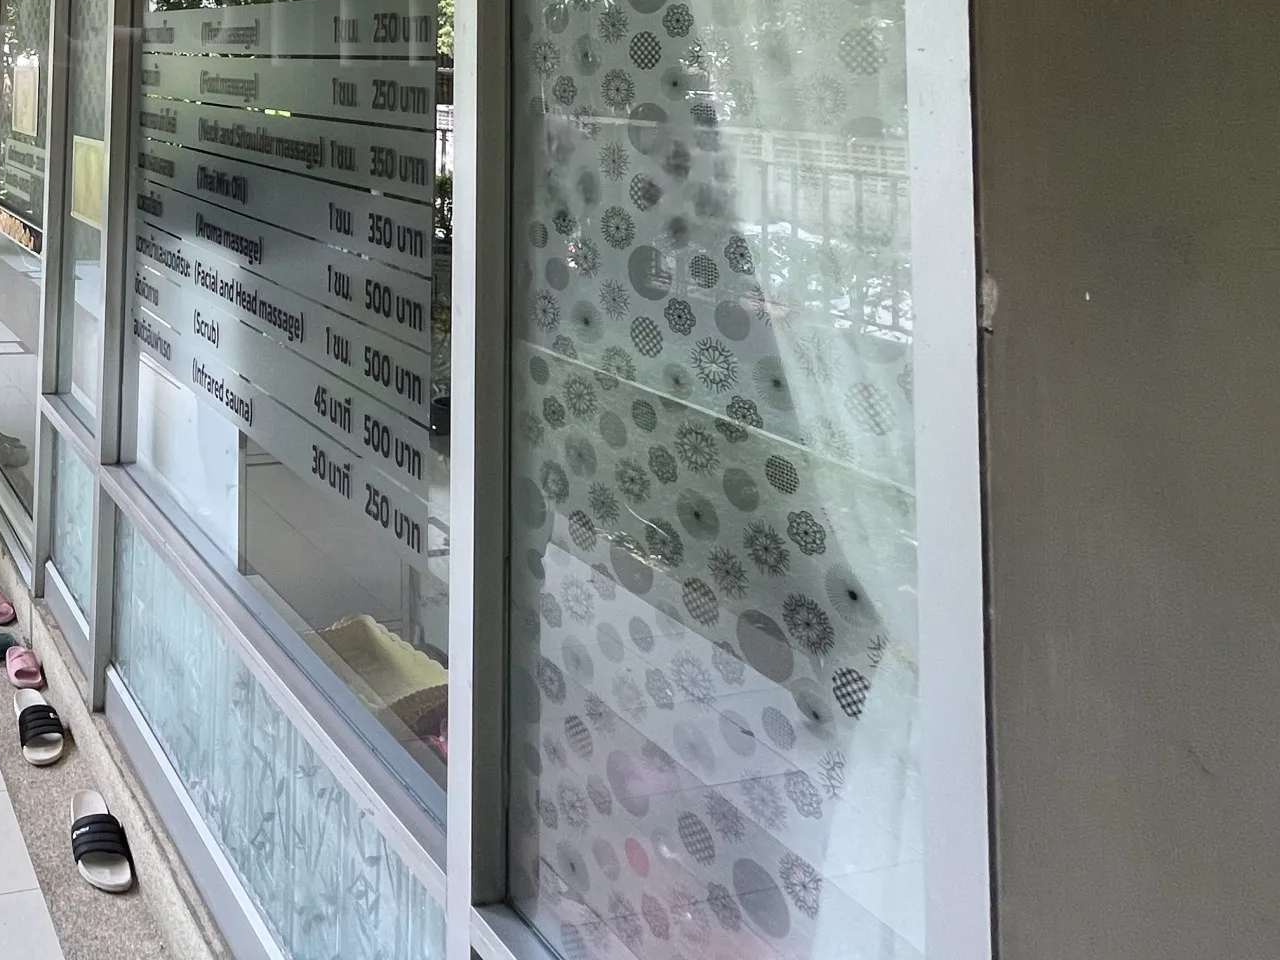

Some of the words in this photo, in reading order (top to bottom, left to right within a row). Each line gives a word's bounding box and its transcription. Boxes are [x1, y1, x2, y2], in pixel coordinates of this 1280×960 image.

[401, 16, 430, 42] บาท
[372, 79, 399, 111] 250
[400, 86, 429, 114] บาท
[275, 136, 325, 169] massage)
[370, 146, 397, 179] 350
[399, 154, 429, 186] บาท
[195, 212, 222, 245] (Aroma
[223, 230, 264, 265] massage)
[365, 279, 392, 318] 500
[396, 295, 424, 332] บาท
[368, 212, 395, 248] 350
[397, 225, 424, 259] บาท
[195, 260, 219, 294] (Facial
[219, 278, 235, 303] and
[236, 283, 258, 316] Head
[259, 299, 304, 343] massage)
[364, 345, 391, 387] 500
[395, 365, 423, 405] บาท
[193, 309, 219, 348] (Scrub)
[314, 384, 327, 417] 45
[330, 397, 352, 433] นาที
[363, 414, 391, 459] 500
[395, 437, 423, 480] บาท
[192, 357, 224, 402] (Infrared
[224, 388, 253, 427] sauna)
[312, 444, 326, 480] 30
[328, 460, 351, 500] นาที
[365, 483, 390, 528] 250
[394, 509, 422, 554] บาท
